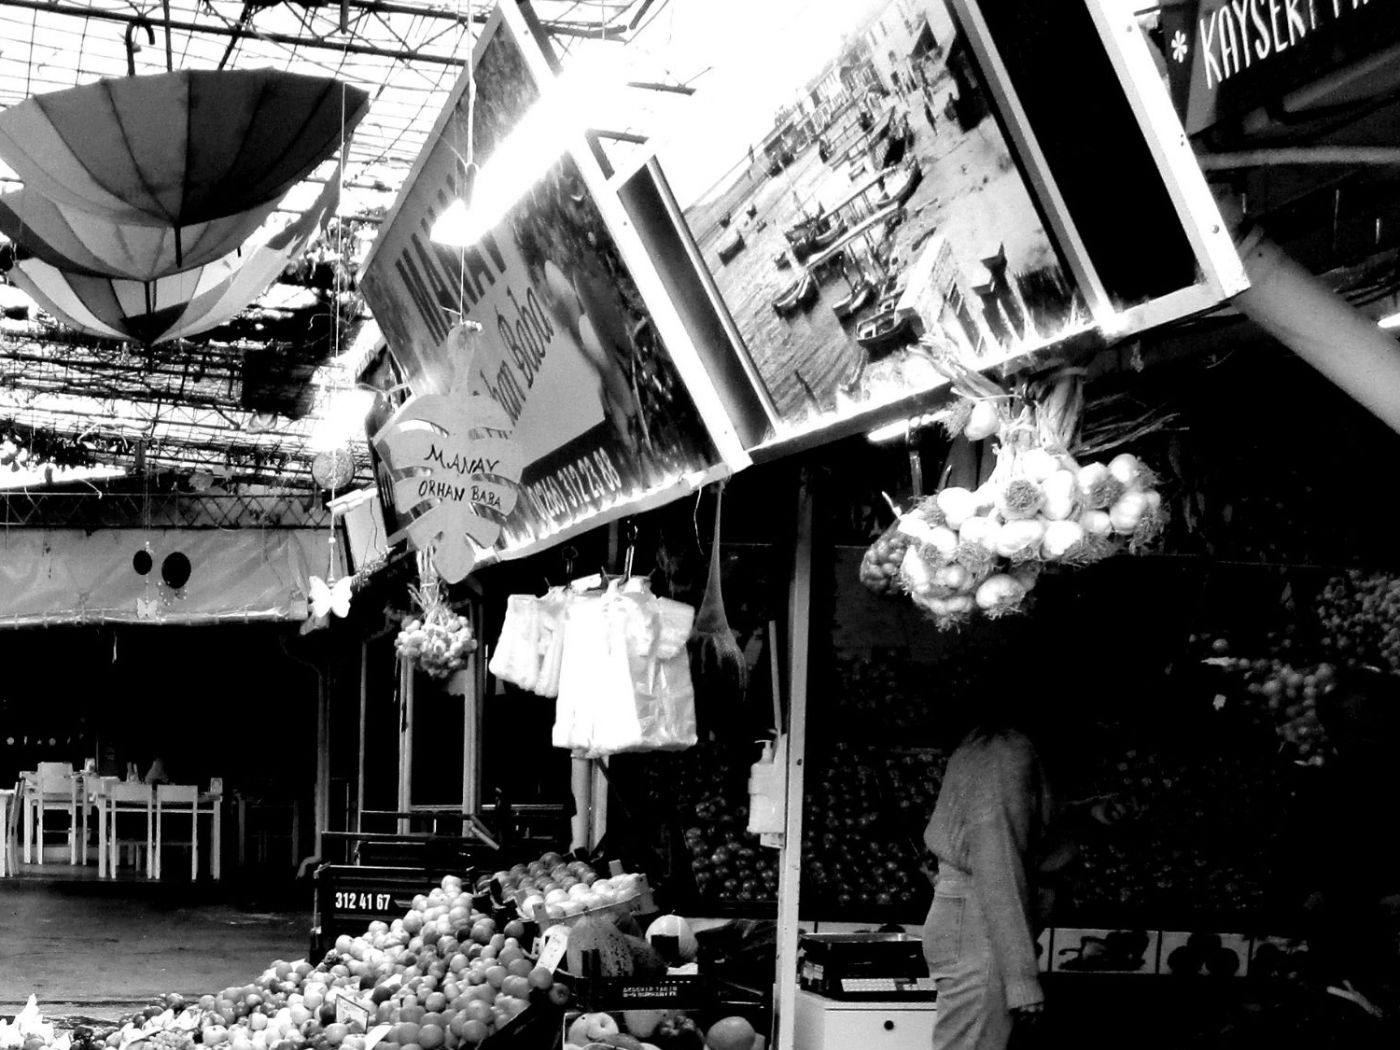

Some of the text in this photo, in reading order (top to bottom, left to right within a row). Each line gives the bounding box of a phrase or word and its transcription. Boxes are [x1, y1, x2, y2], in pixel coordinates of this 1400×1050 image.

[592, 446, 622, 492] 88
[417, 479, 502, 507] ORHAN BABA
[335, 892, 391, 911] 312 41 67
